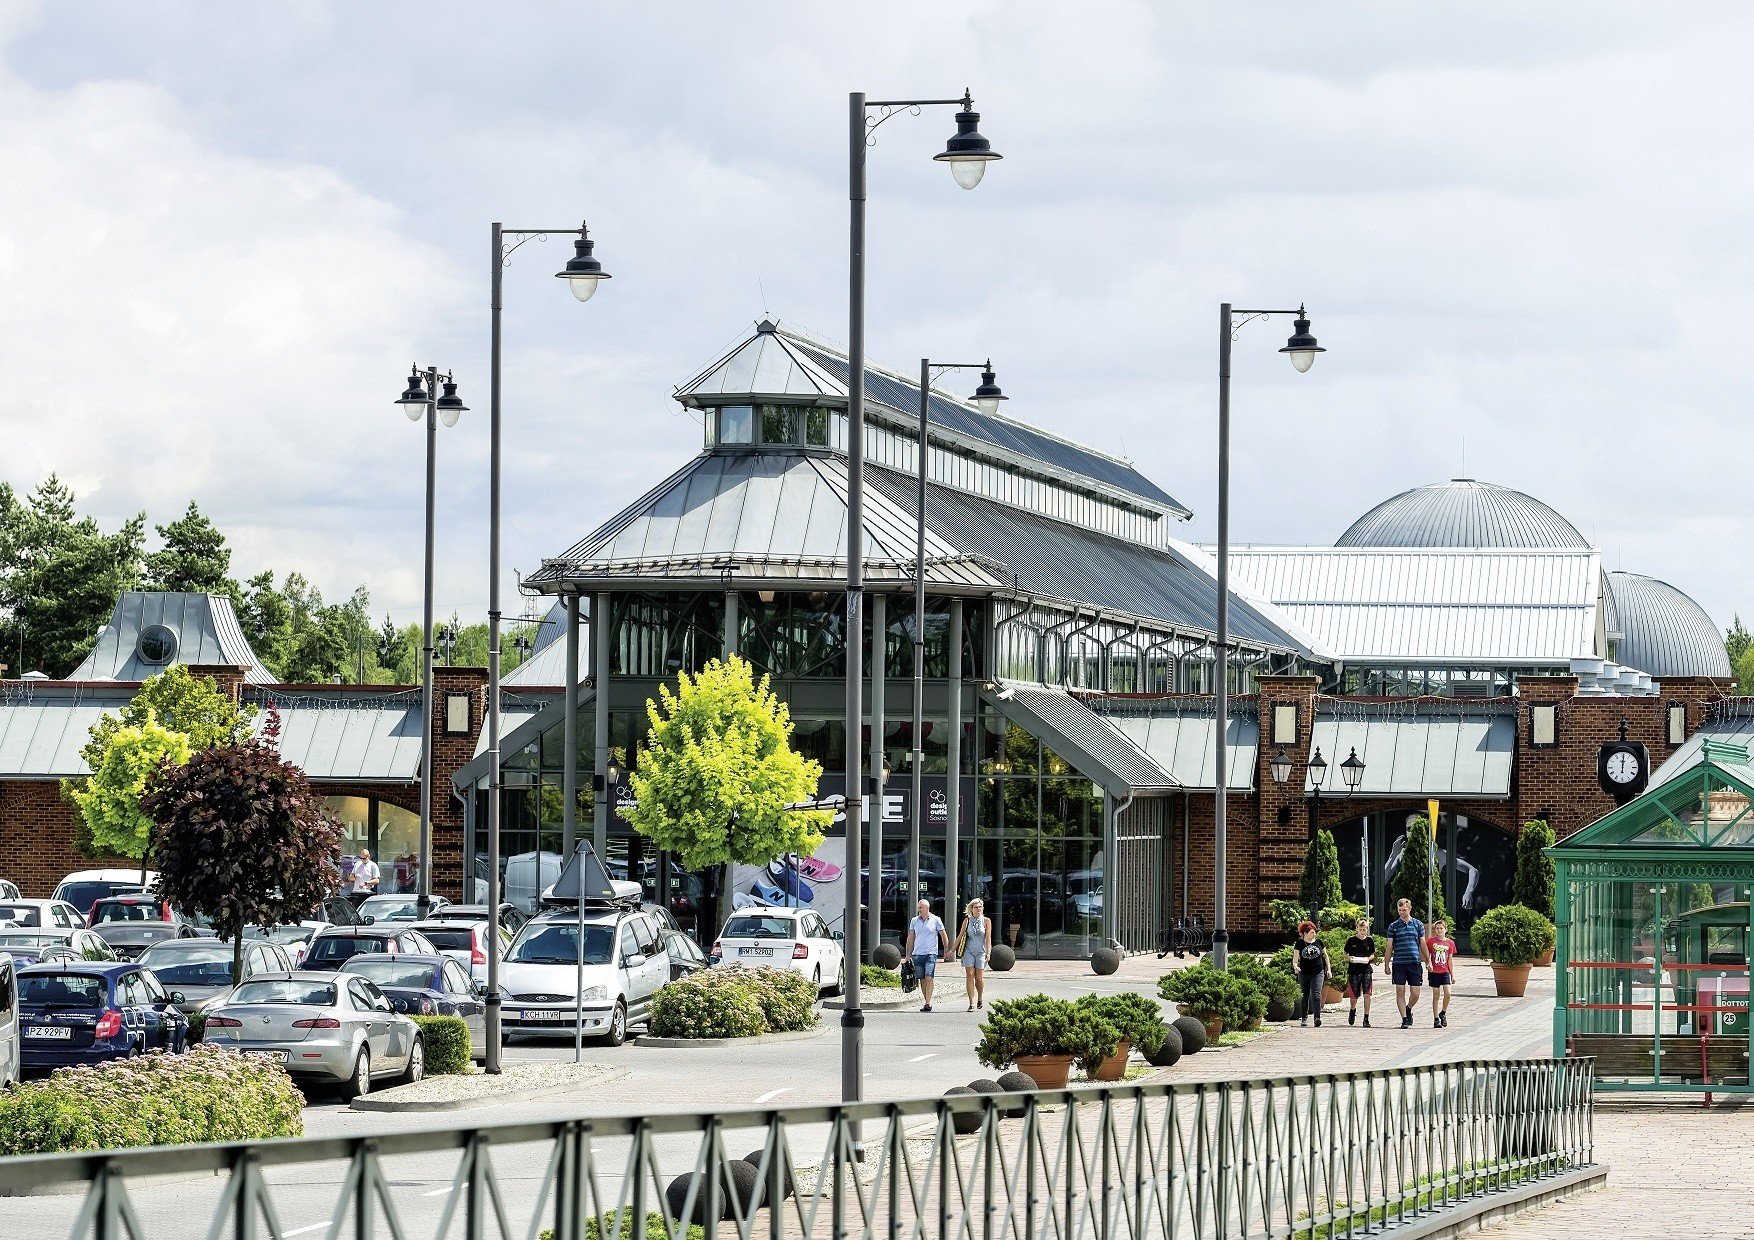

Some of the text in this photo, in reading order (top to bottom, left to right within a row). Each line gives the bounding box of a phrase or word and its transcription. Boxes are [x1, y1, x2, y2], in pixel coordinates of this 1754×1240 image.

[340, 821, 391, 841] NLY
[524, 1011, 540, 1019] KCH
[1725, 1014, 1734, 1023] 25
[29, 1027, 42, 1036] PZ
